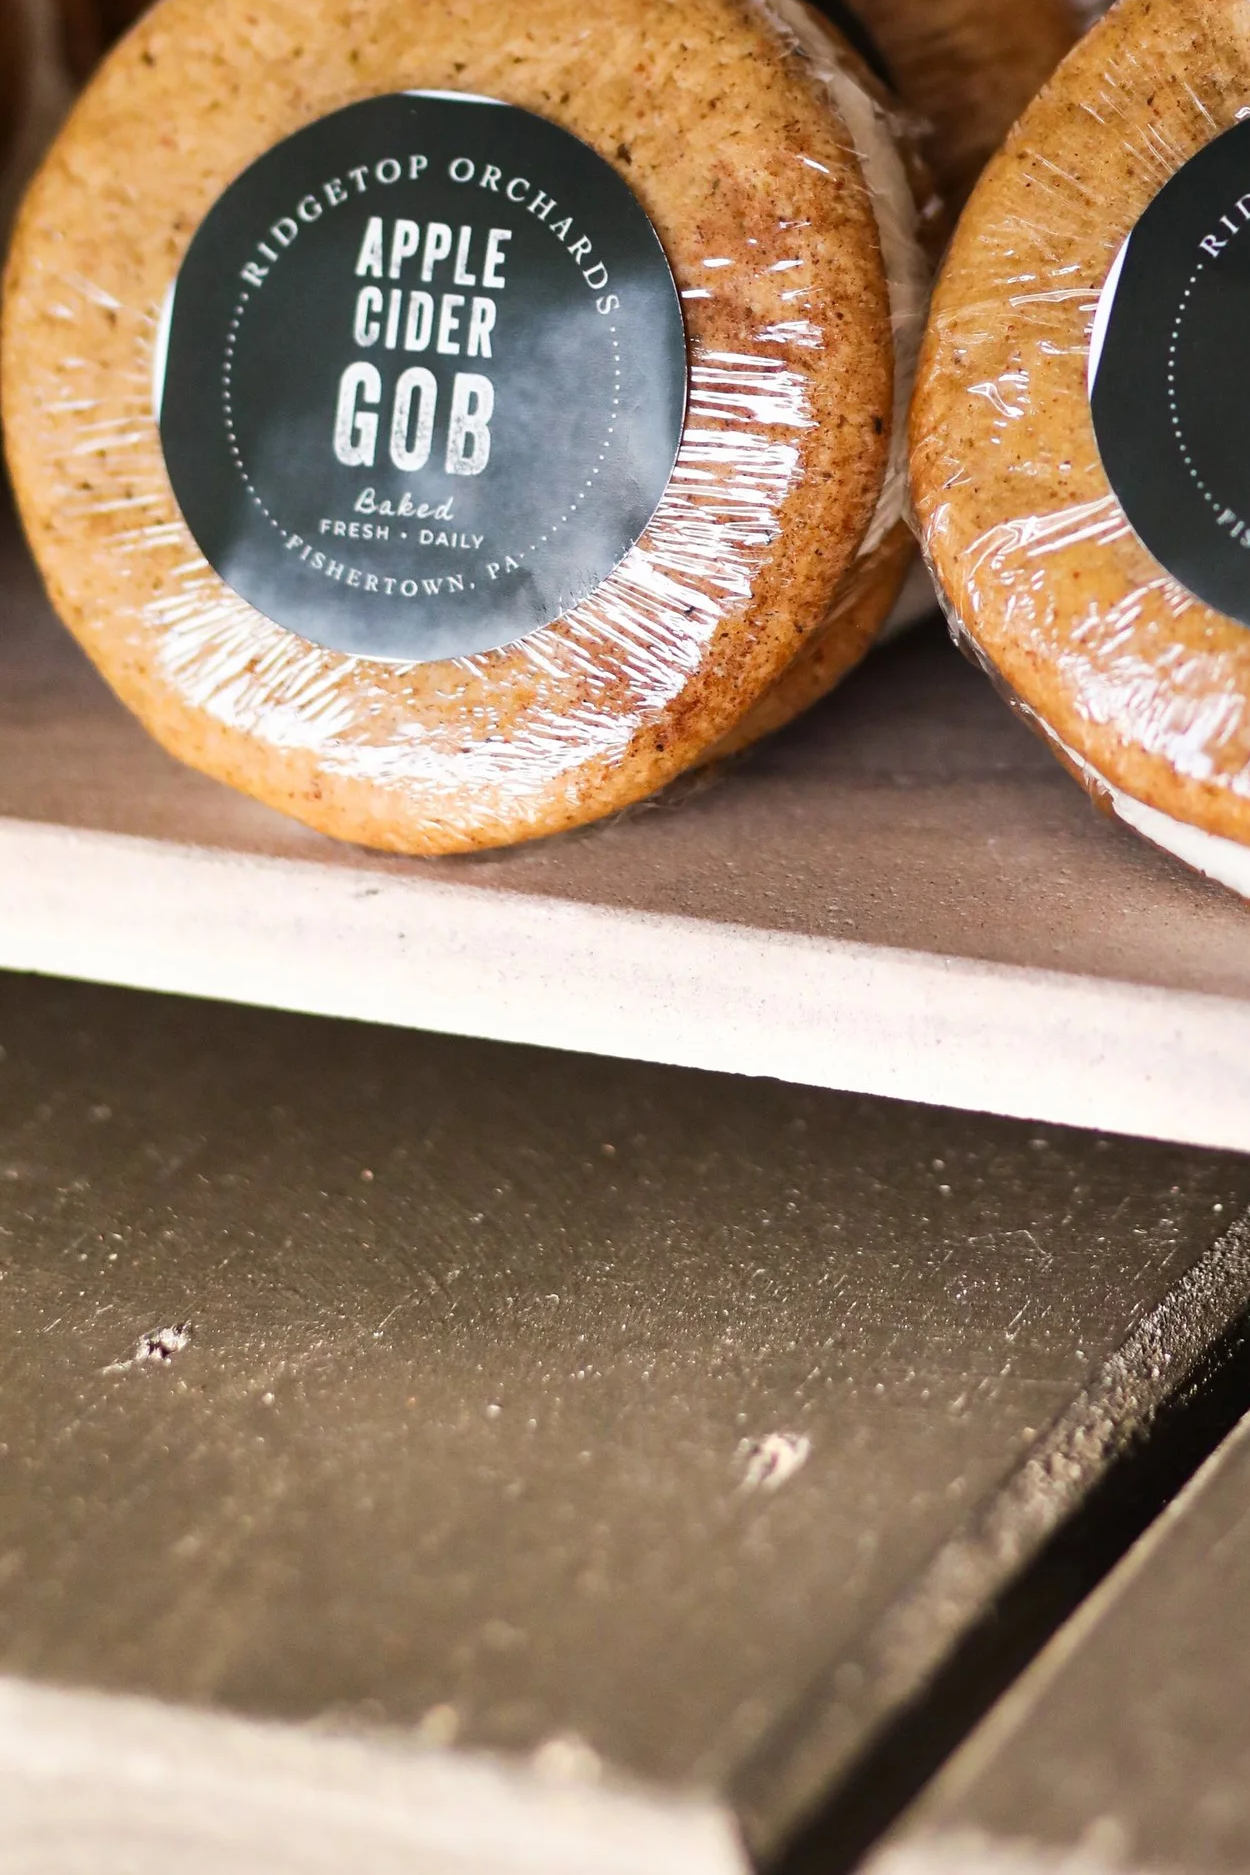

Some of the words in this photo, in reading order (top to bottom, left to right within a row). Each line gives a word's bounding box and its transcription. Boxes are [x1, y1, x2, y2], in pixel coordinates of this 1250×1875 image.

[239, 154, 428, 289] RIDGETOP
[448, 157, 620, 316] ORCHARDS
[354, 216, 512, 289] APPLE
[353, 286, 497, 359] CIDER
[333, 361, 495, 476] GOB
[318, 518, 390, 540] FRESH
[419, 528, 485, 550] DAILY
[354, 487, 455, 521] Baked
